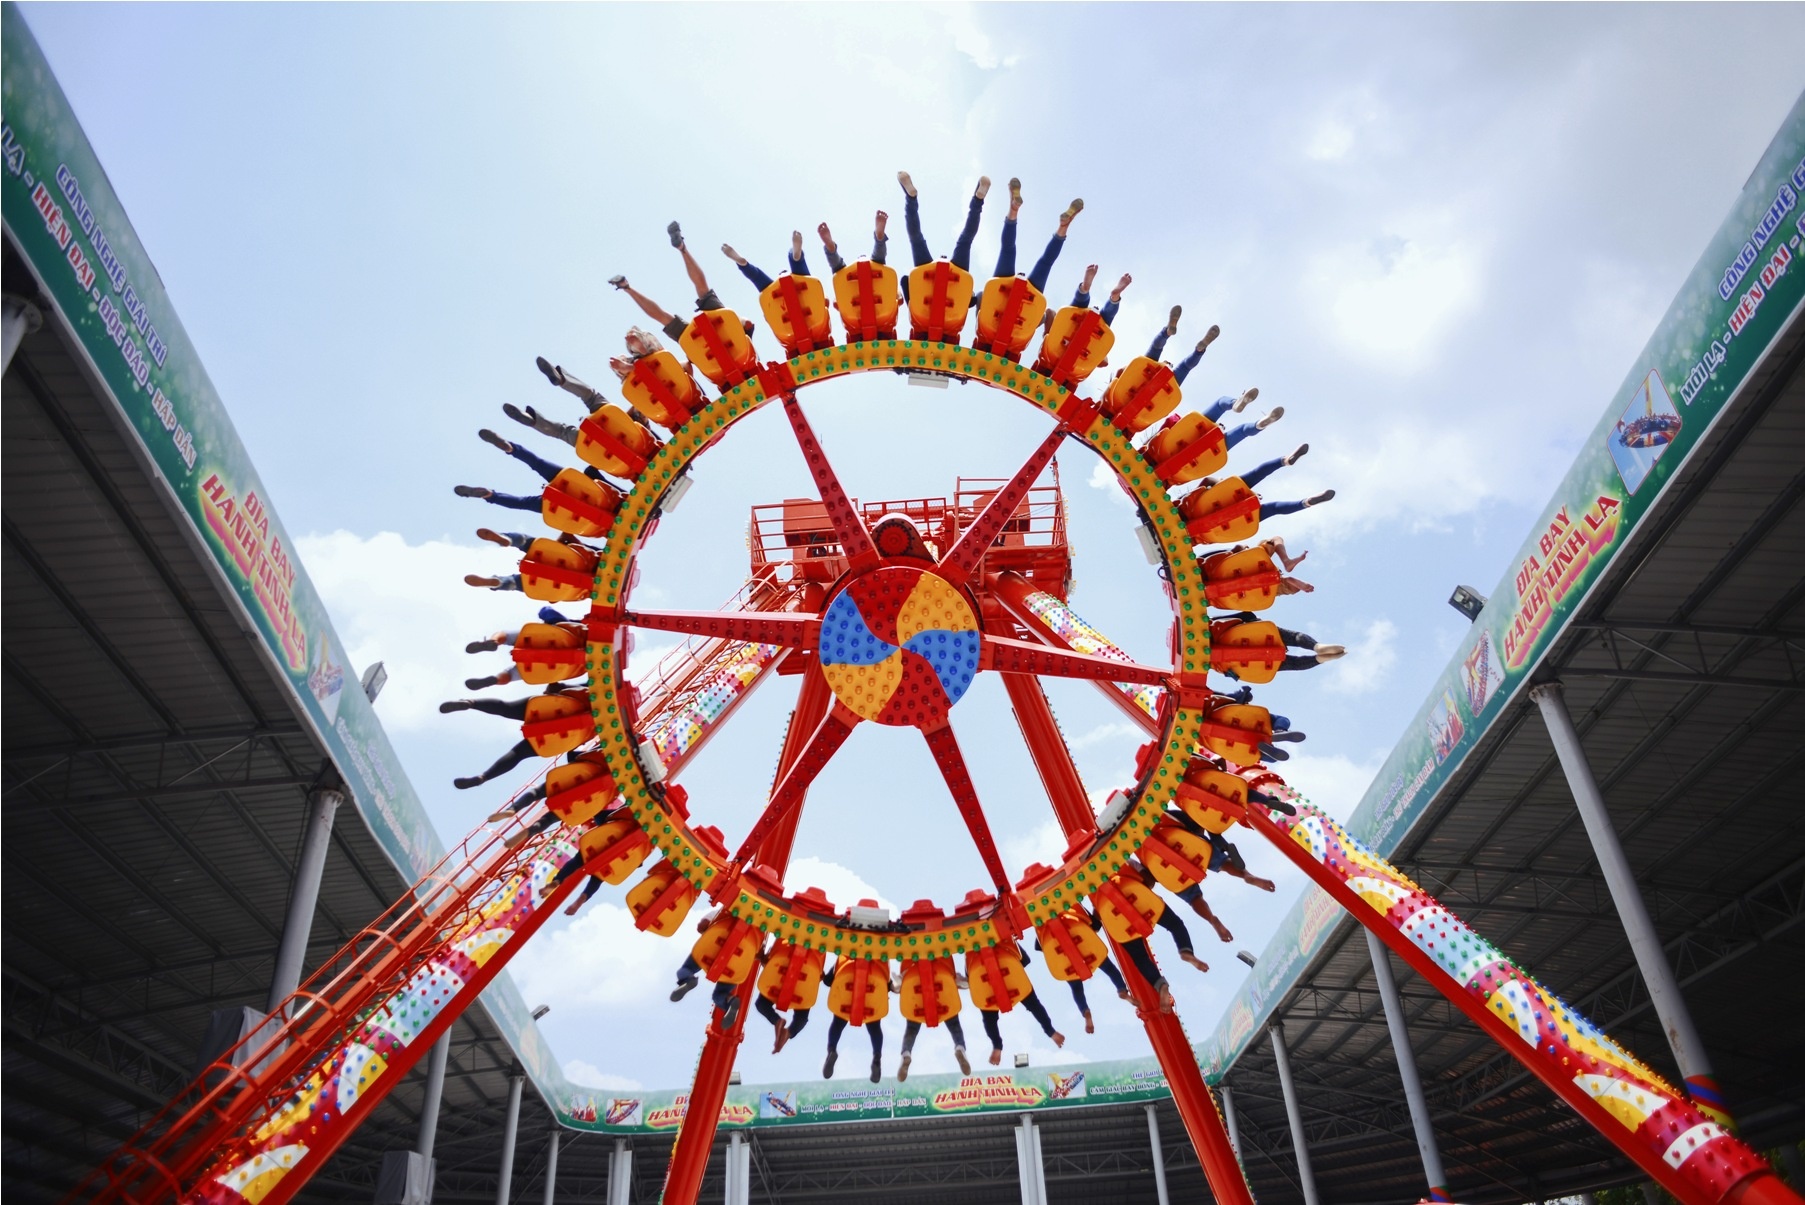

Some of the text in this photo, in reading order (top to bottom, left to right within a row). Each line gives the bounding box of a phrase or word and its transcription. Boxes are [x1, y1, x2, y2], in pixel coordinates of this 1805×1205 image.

[32, 181, 72, 250] HIỆN
[67, 241, 95, 291] ĐẠI
[97, 295, 127, 347] ĐỘC
[122, 336, 148, 387] ĐÁO
[151, 388, 177, 431] HẤP
[56, 163, 168, 368] CÔNG NGHỆ GIẢI TRÍ
[1718, 183, 1798, 300] CÔNG NGHỆ
[1680, 361, 1708, 405] MỚI
[1706, 340, 1727, 373] LẠ
[1728, 280, 1767, 337] HIỆN
[1759, 242, 1793, 290] ĐẠI
[202, 473, 258, 559] HÀNH
[257, 551, 290, 622] TINH
[244, 490, 297, 589] ĐĨA BAY
[1503, 495, 1621, 663] HÀNH TINH LẠ
[1515, 504, 1570, 598] ĐĨA BAY
[982, 1087, 1017, 1098] TINH
[987, 1075, 1012, 1085] BAY
